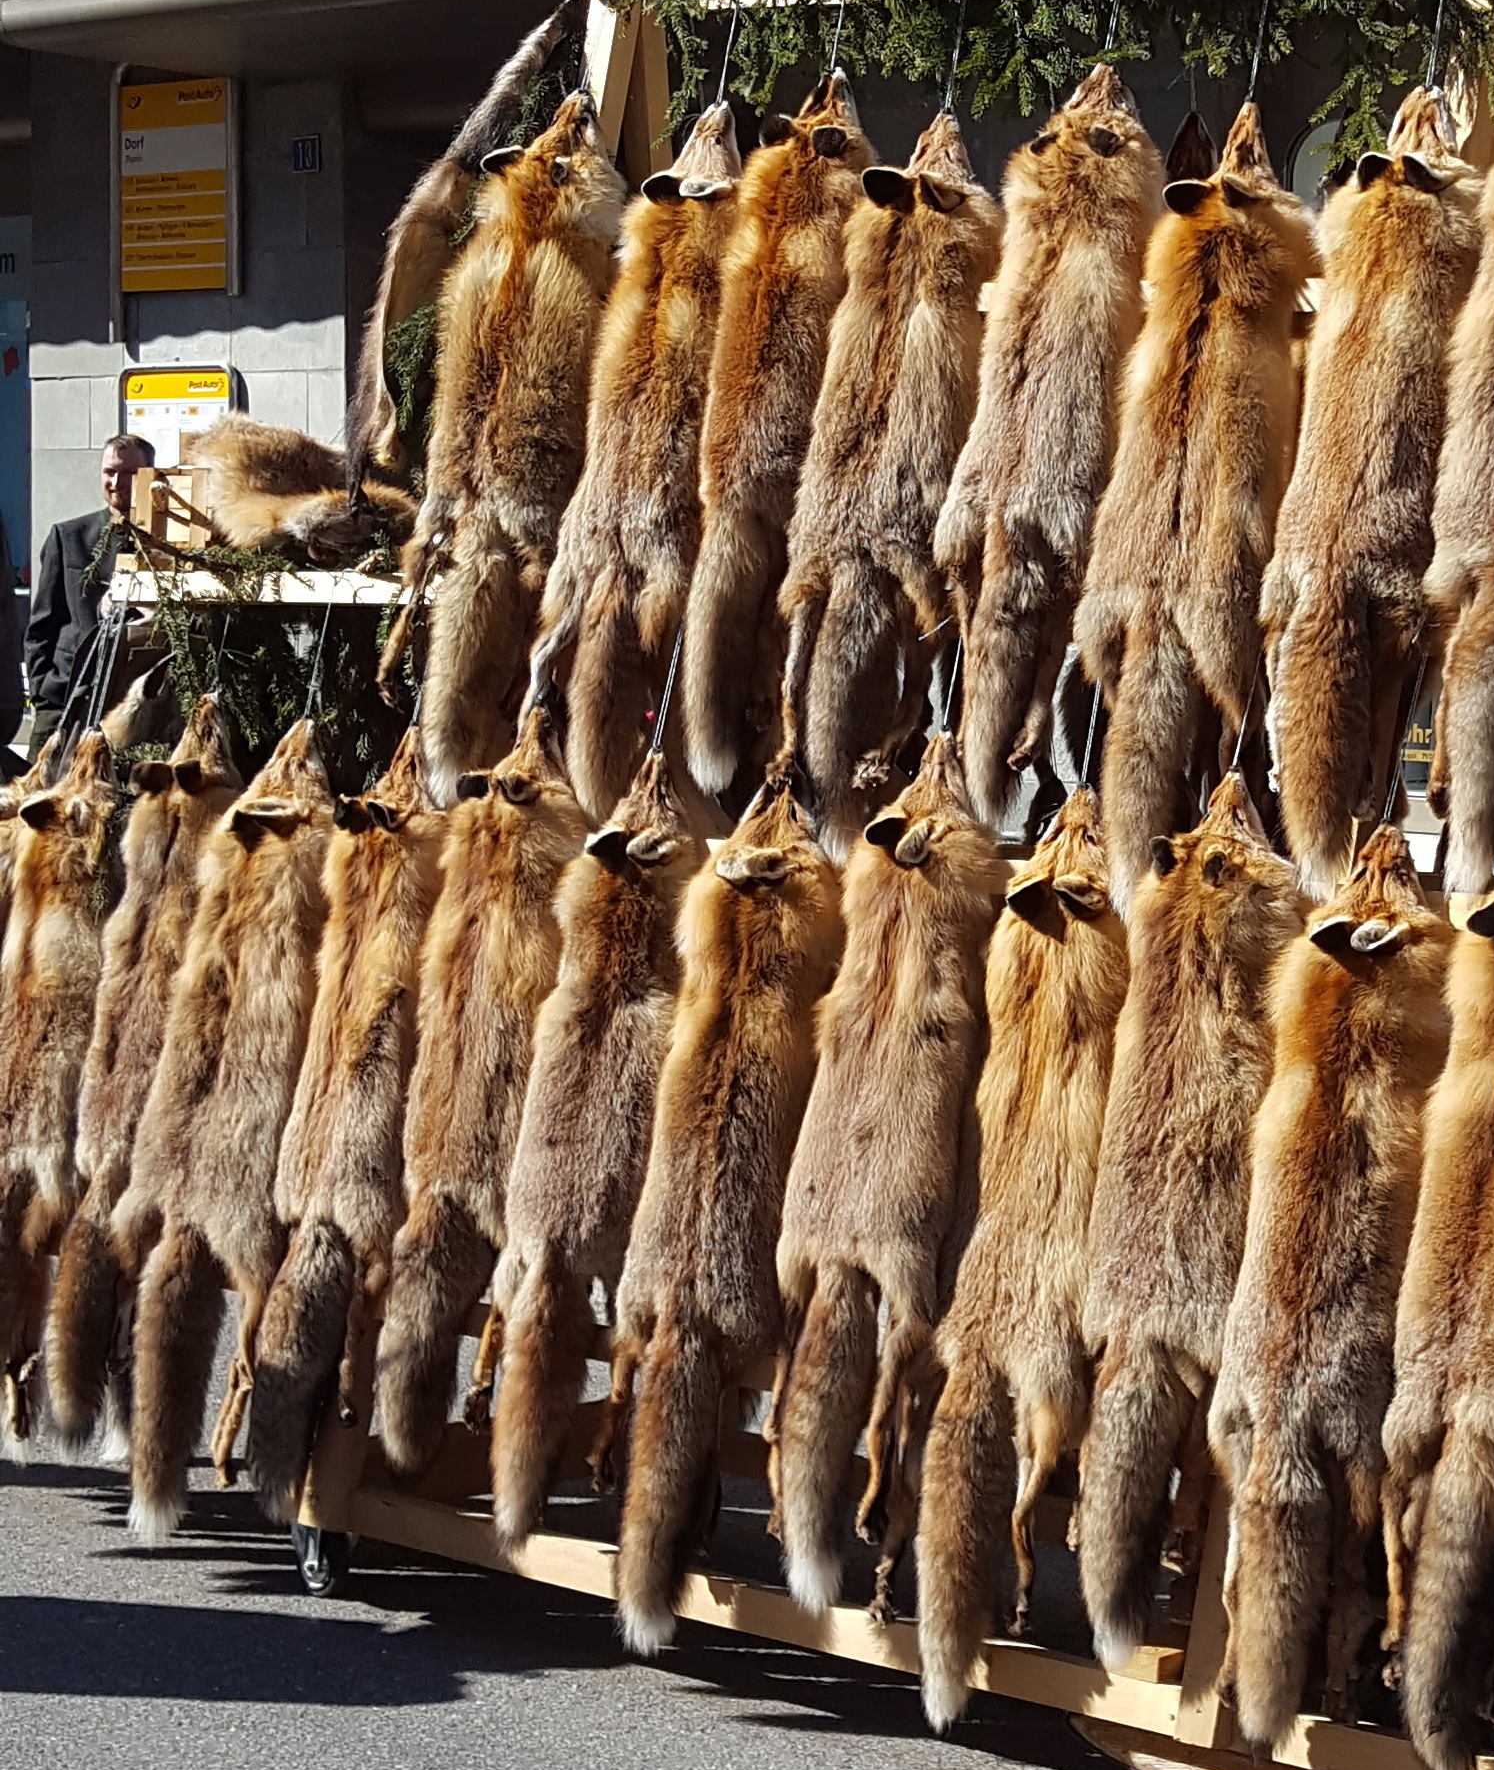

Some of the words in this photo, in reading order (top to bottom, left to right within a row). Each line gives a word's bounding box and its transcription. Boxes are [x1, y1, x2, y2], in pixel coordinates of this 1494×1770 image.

[124, 135, 144, 150] Dorf
[298, 140, 313, 169] 13
[187, 380, 219, 390] PostAuto
